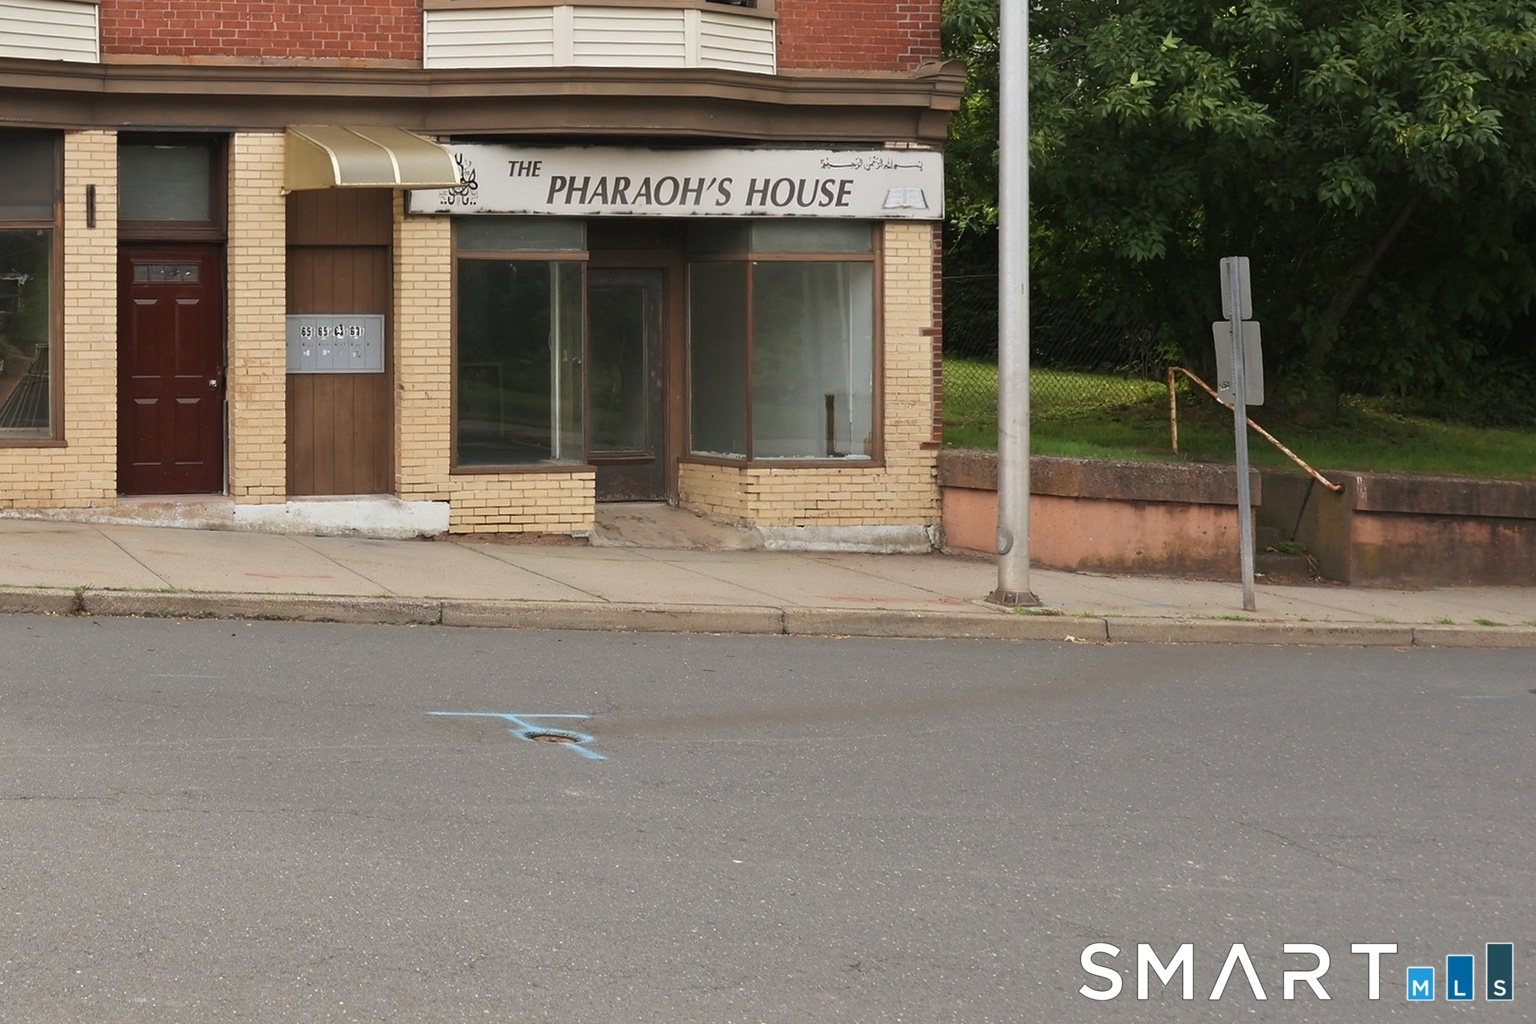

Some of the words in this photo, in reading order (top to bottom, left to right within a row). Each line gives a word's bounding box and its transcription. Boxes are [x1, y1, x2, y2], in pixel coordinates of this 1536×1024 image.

[508, 160, 542, 177] THE
[546, 175, 733, 207] PHARAOH'S
[745, 178, 855, 208] HOUSE
